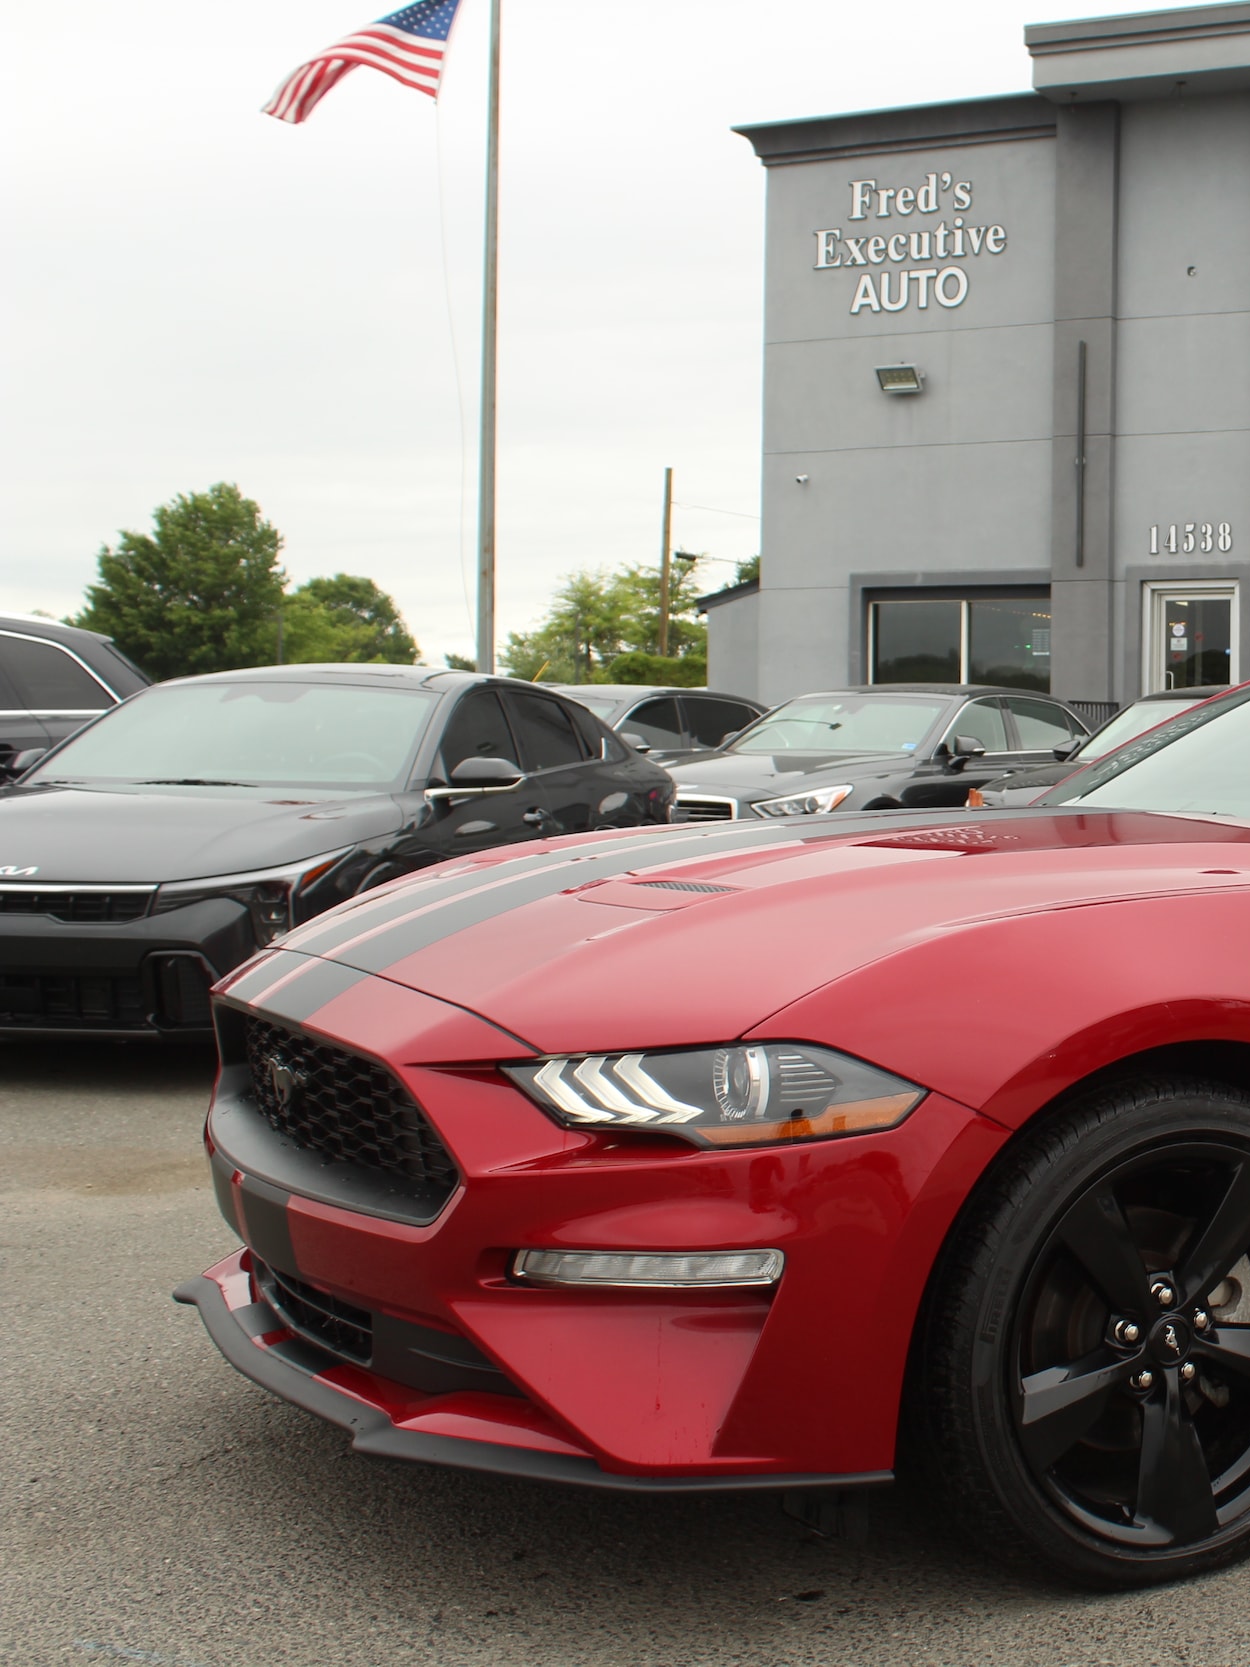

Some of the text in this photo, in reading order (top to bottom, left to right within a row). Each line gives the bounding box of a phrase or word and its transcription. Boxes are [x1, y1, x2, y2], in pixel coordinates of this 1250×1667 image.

[848, 171, 973, 220] Fred's
[813, 217, 1007, 270] Executive
[850, 265, 969, 314] AUTO
[1149, 522, 1233, 554] 14538
